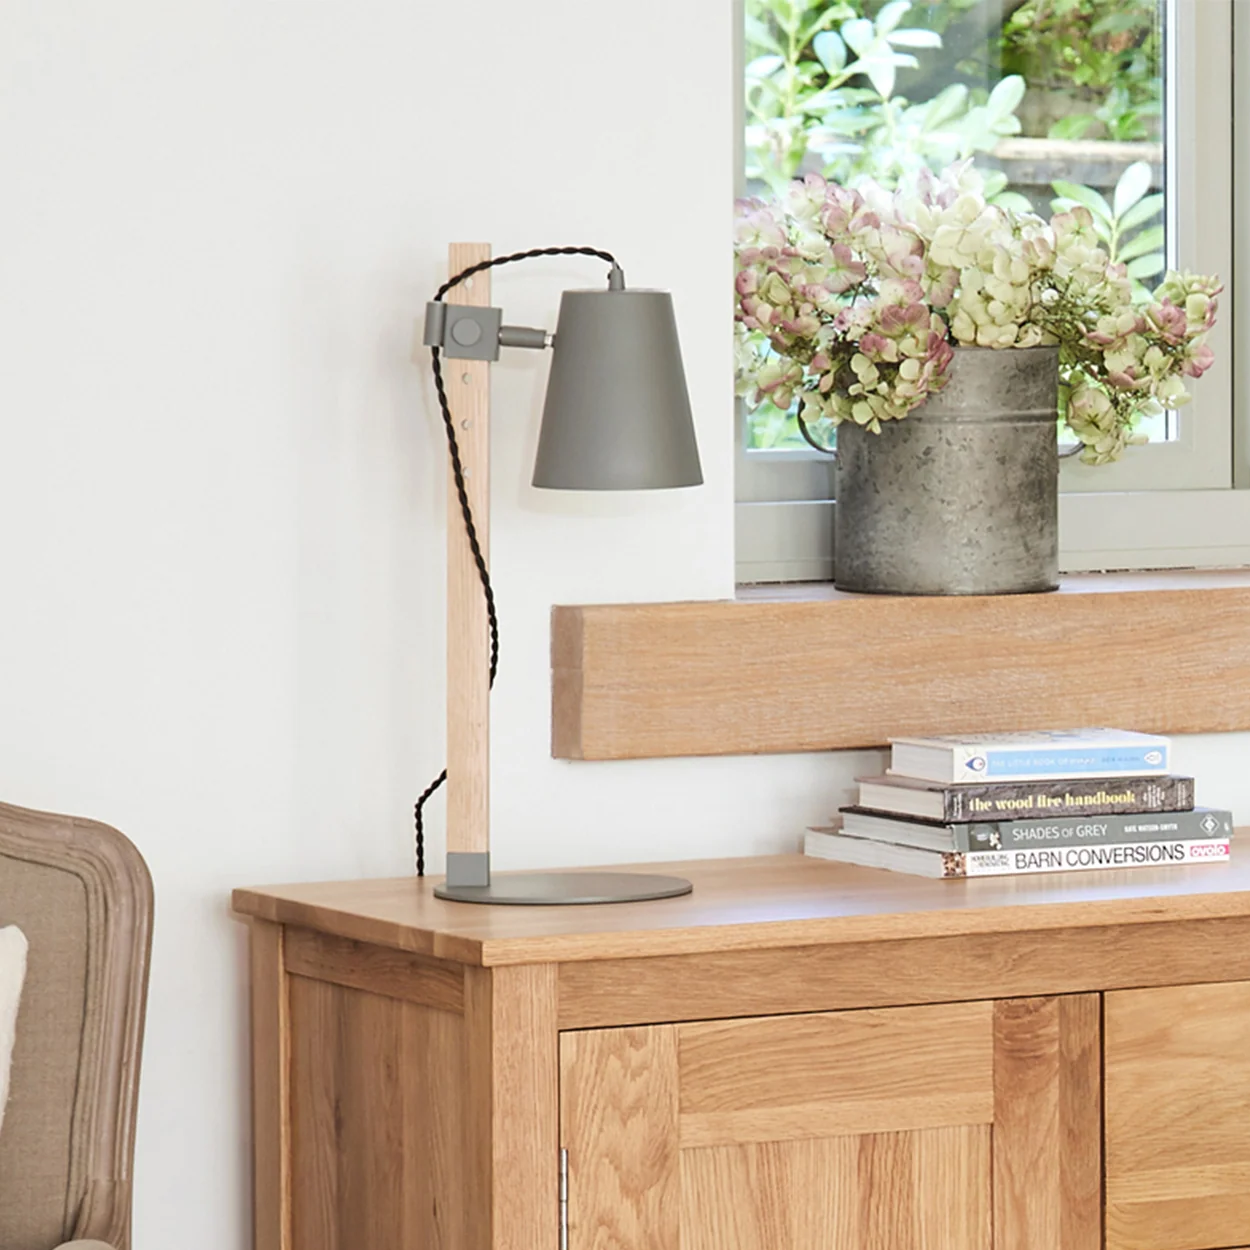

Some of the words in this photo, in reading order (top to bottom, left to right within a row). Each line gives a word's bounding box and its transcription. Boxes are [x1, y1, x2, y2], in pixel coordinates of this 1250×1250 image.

[969, 797, 992, 812] the
[995, 795, 1033, 811] wood
[1037, 793, 1063, 809] fire
[1064, 790, 1136, 807] handbook
[1012, 825, 1060, 842] SHADES
[1062, 827, 1074, 838] OF
[1076, 823, 1108, 839] GREY
[1015, 848, 1062, 870] BARN
[1066, 843, 1185, 867] CONVERSIONS
